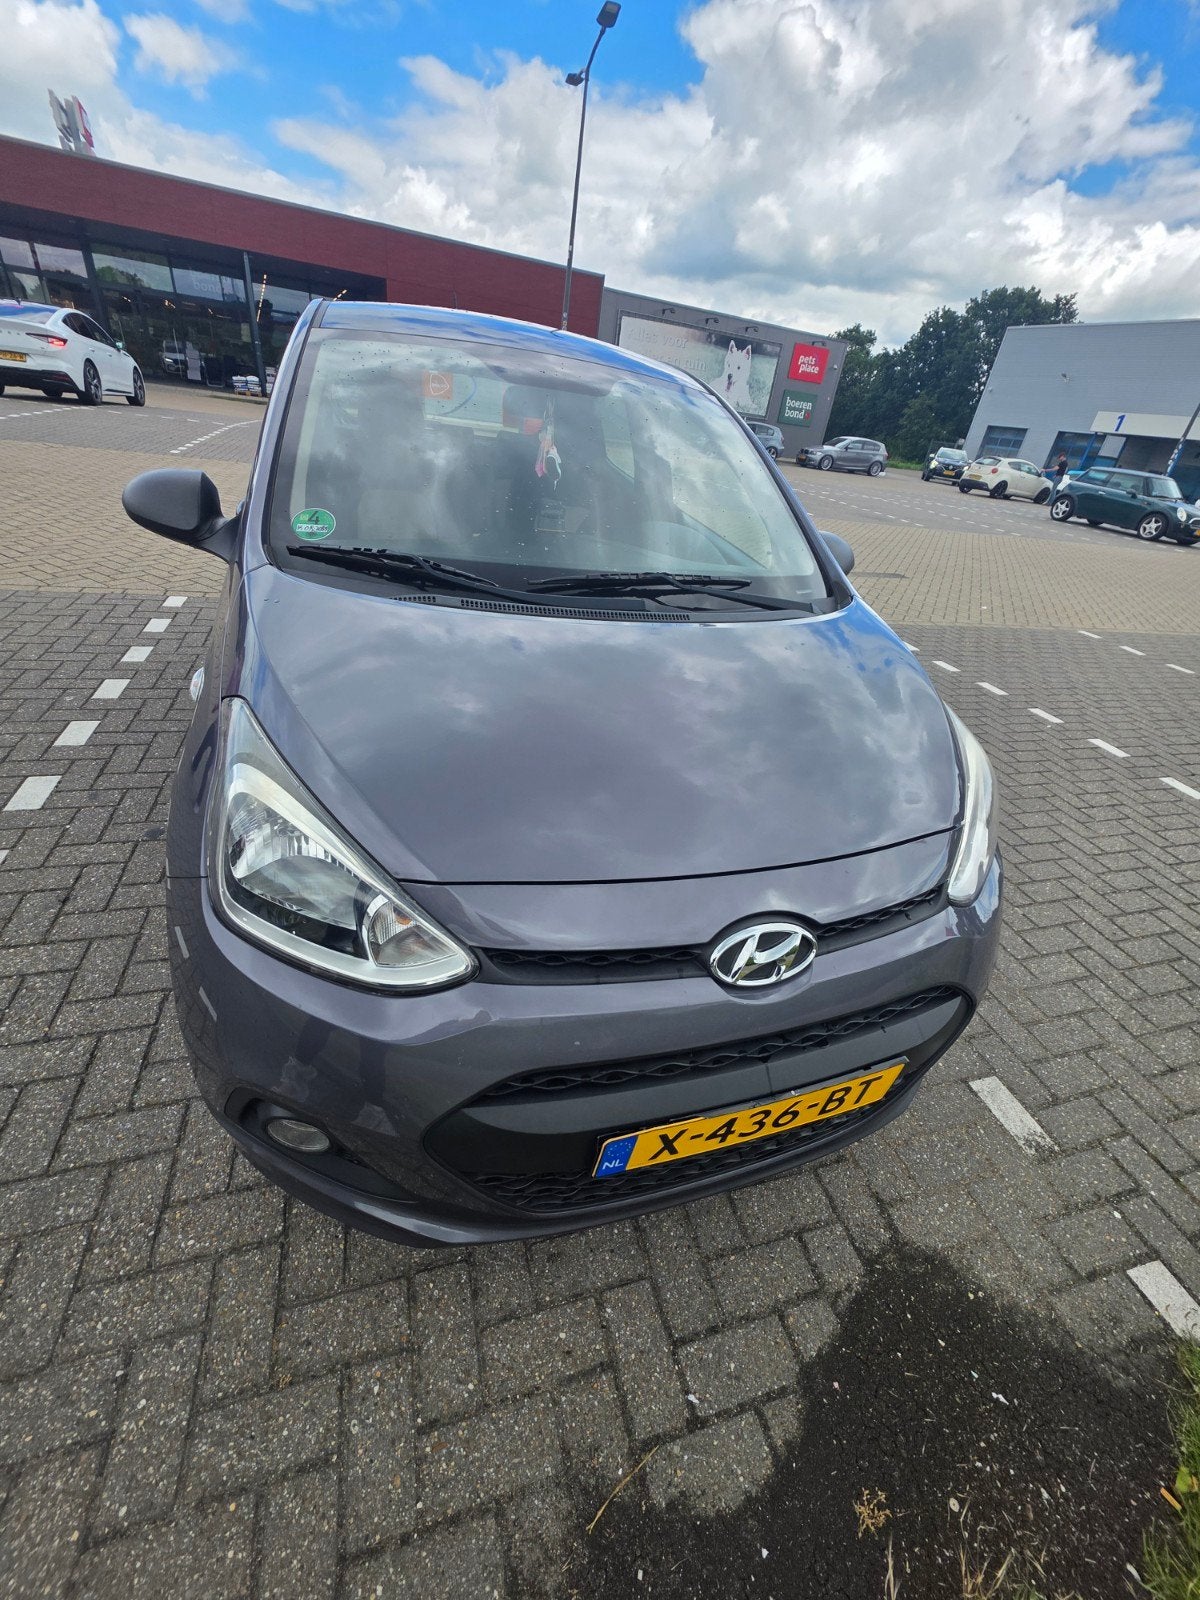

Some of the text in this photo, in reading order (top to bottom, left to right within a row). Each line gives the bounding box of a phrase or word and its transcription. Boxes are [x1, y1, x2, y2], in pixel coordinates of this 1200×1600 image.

[663, 335, 689, 349] voor
[798, 355, 816, 365] pets
[799, 363, 819, 374] place
[786, 396, 812, 410] boeren
[784, 406, 805, 419] bond
[1115, 414, 1126, 432] 1
[307, 510, 320, 525] 4
[602, 1075, 883, 1170] NL X-436-BT
